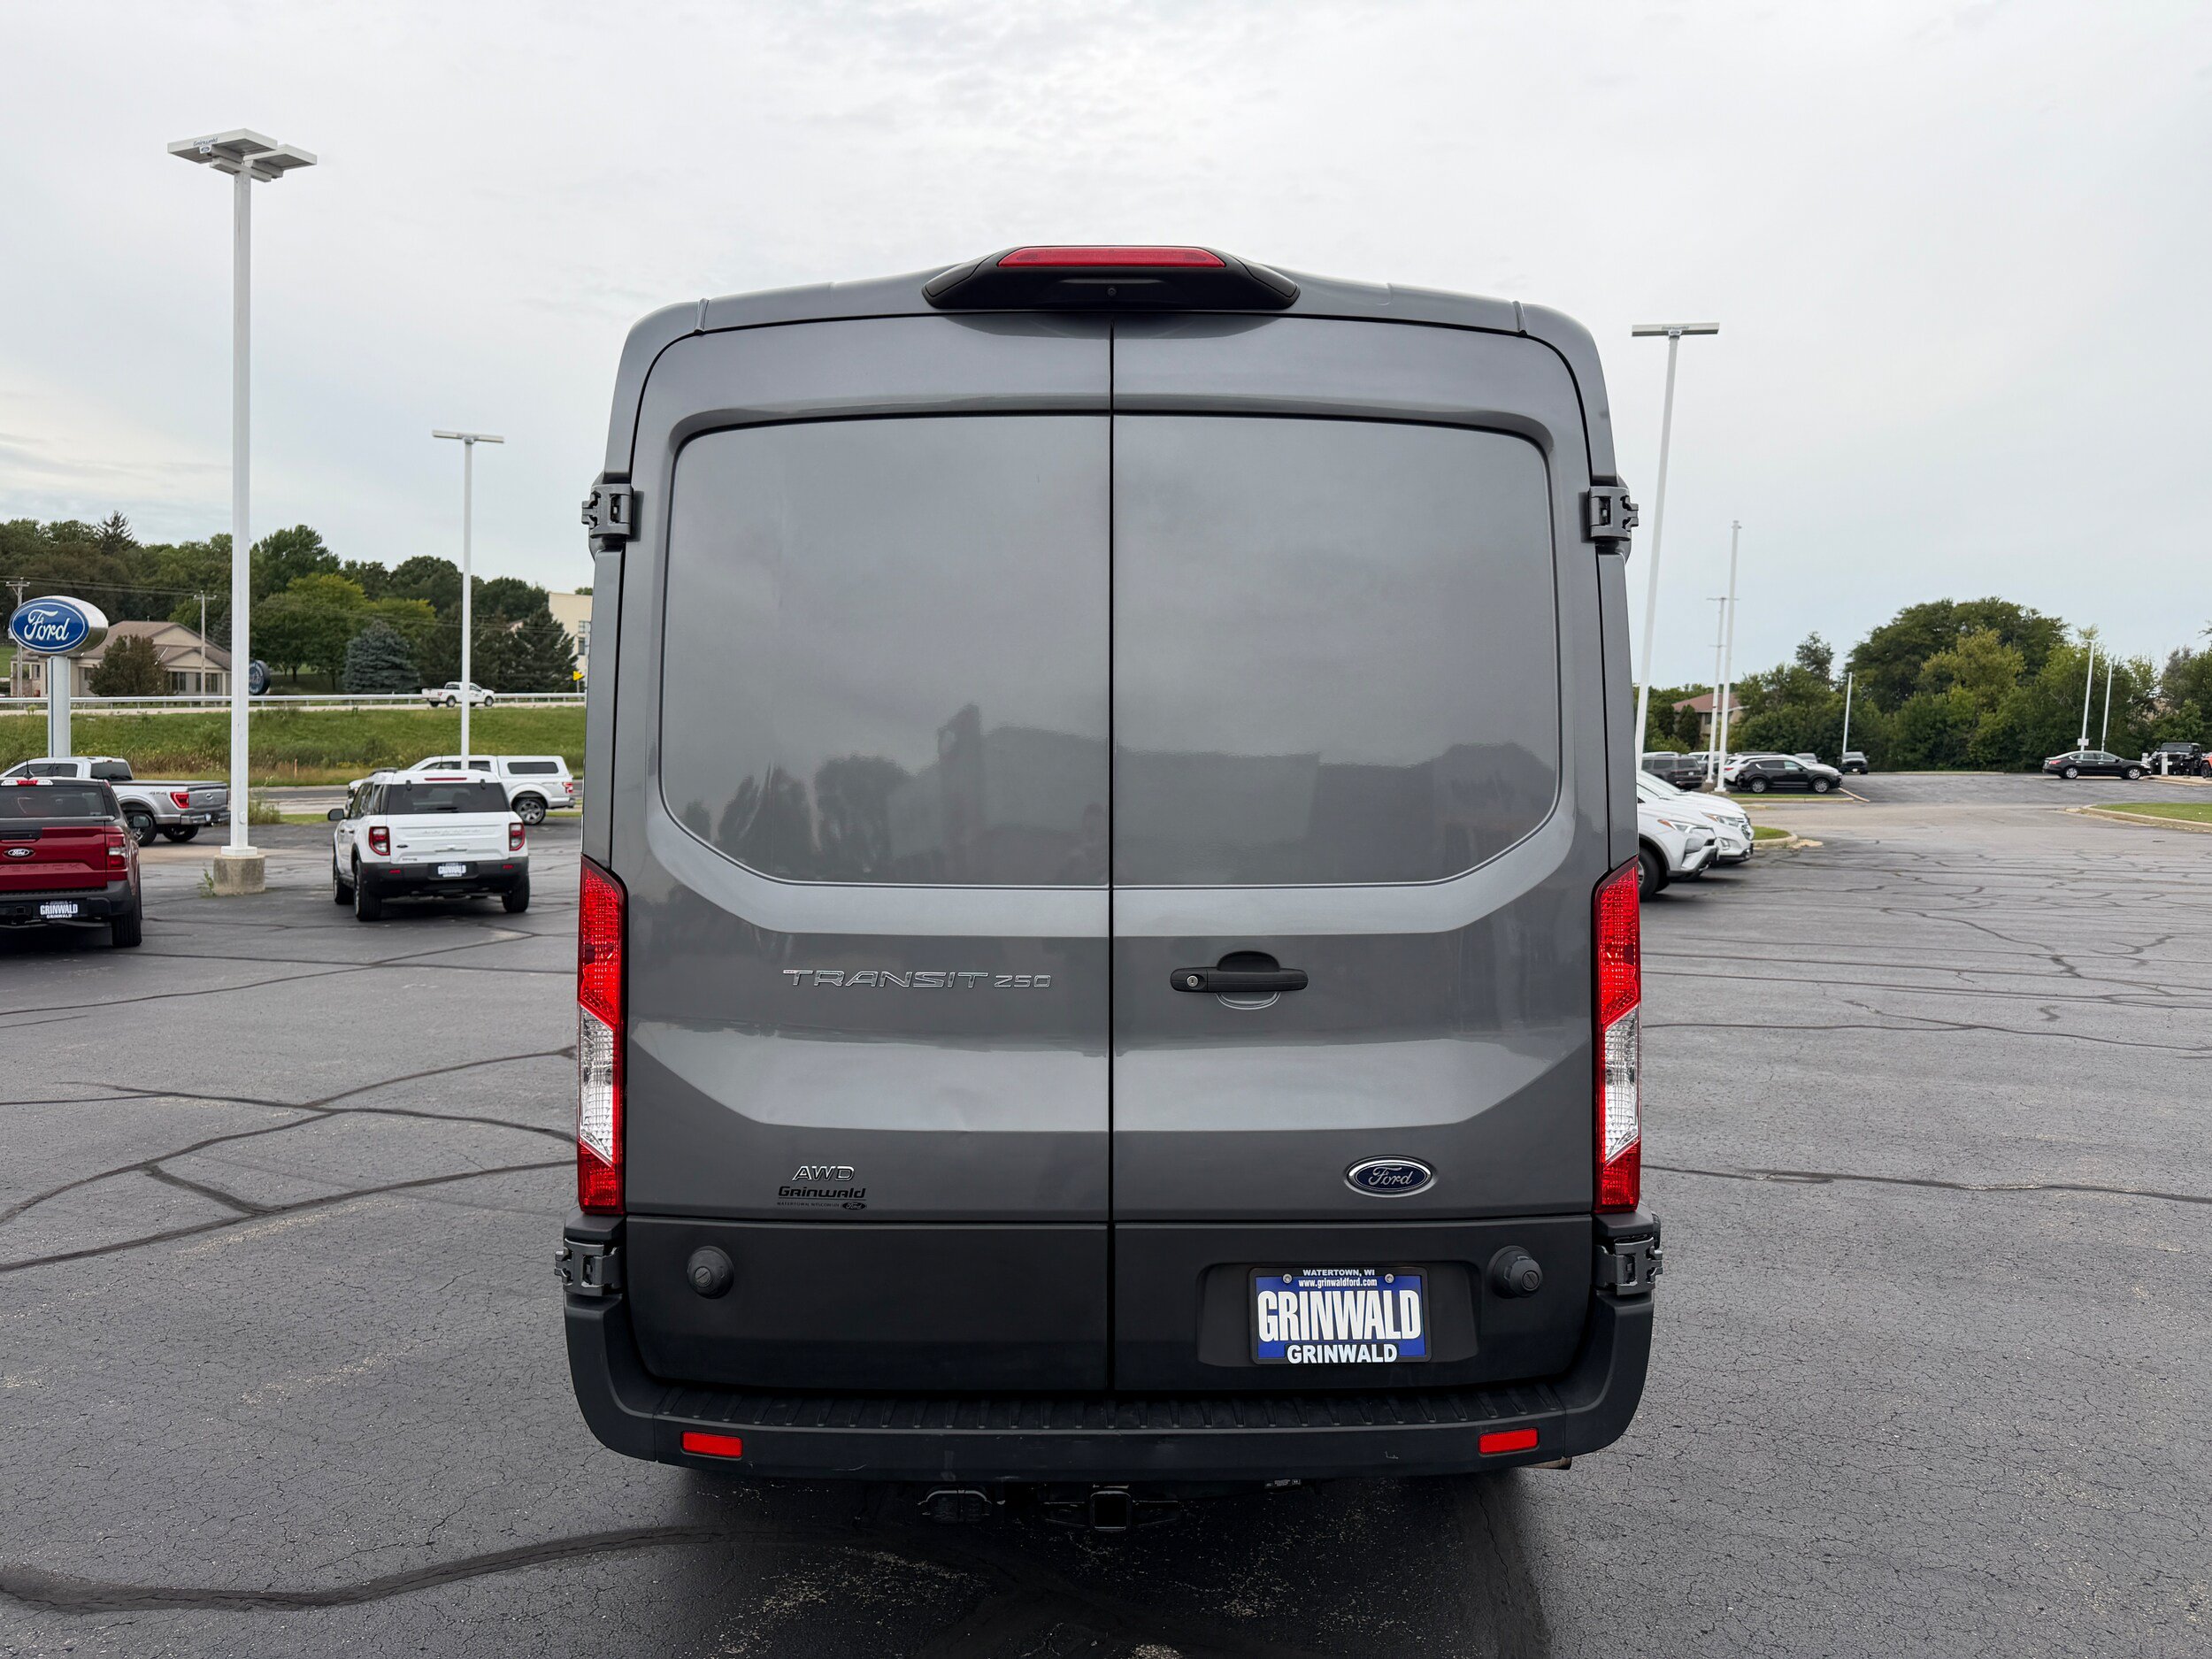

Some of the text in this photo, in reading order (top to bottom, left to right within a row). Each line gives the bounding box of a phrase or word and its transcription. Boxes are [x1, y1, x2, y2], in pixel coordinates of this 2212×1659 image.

[24, 609, 70, 641] Ford
[40, 904, 78, 915] GRINWALD
[782, 969, 1052, 988] TRANSIT 250
[791, 1165, 856, 1181] AWD
[1368, 1166, 1414, 1186] Ford
[779, 1186, 867, 1198] Grinwald
[1298, 1277, 1377, 1288] www.grinwaldford.com
[1257, 1289, 1422, 1343] GRINWALD
[1286, 1343, 1398, 1364] GRINWALD
